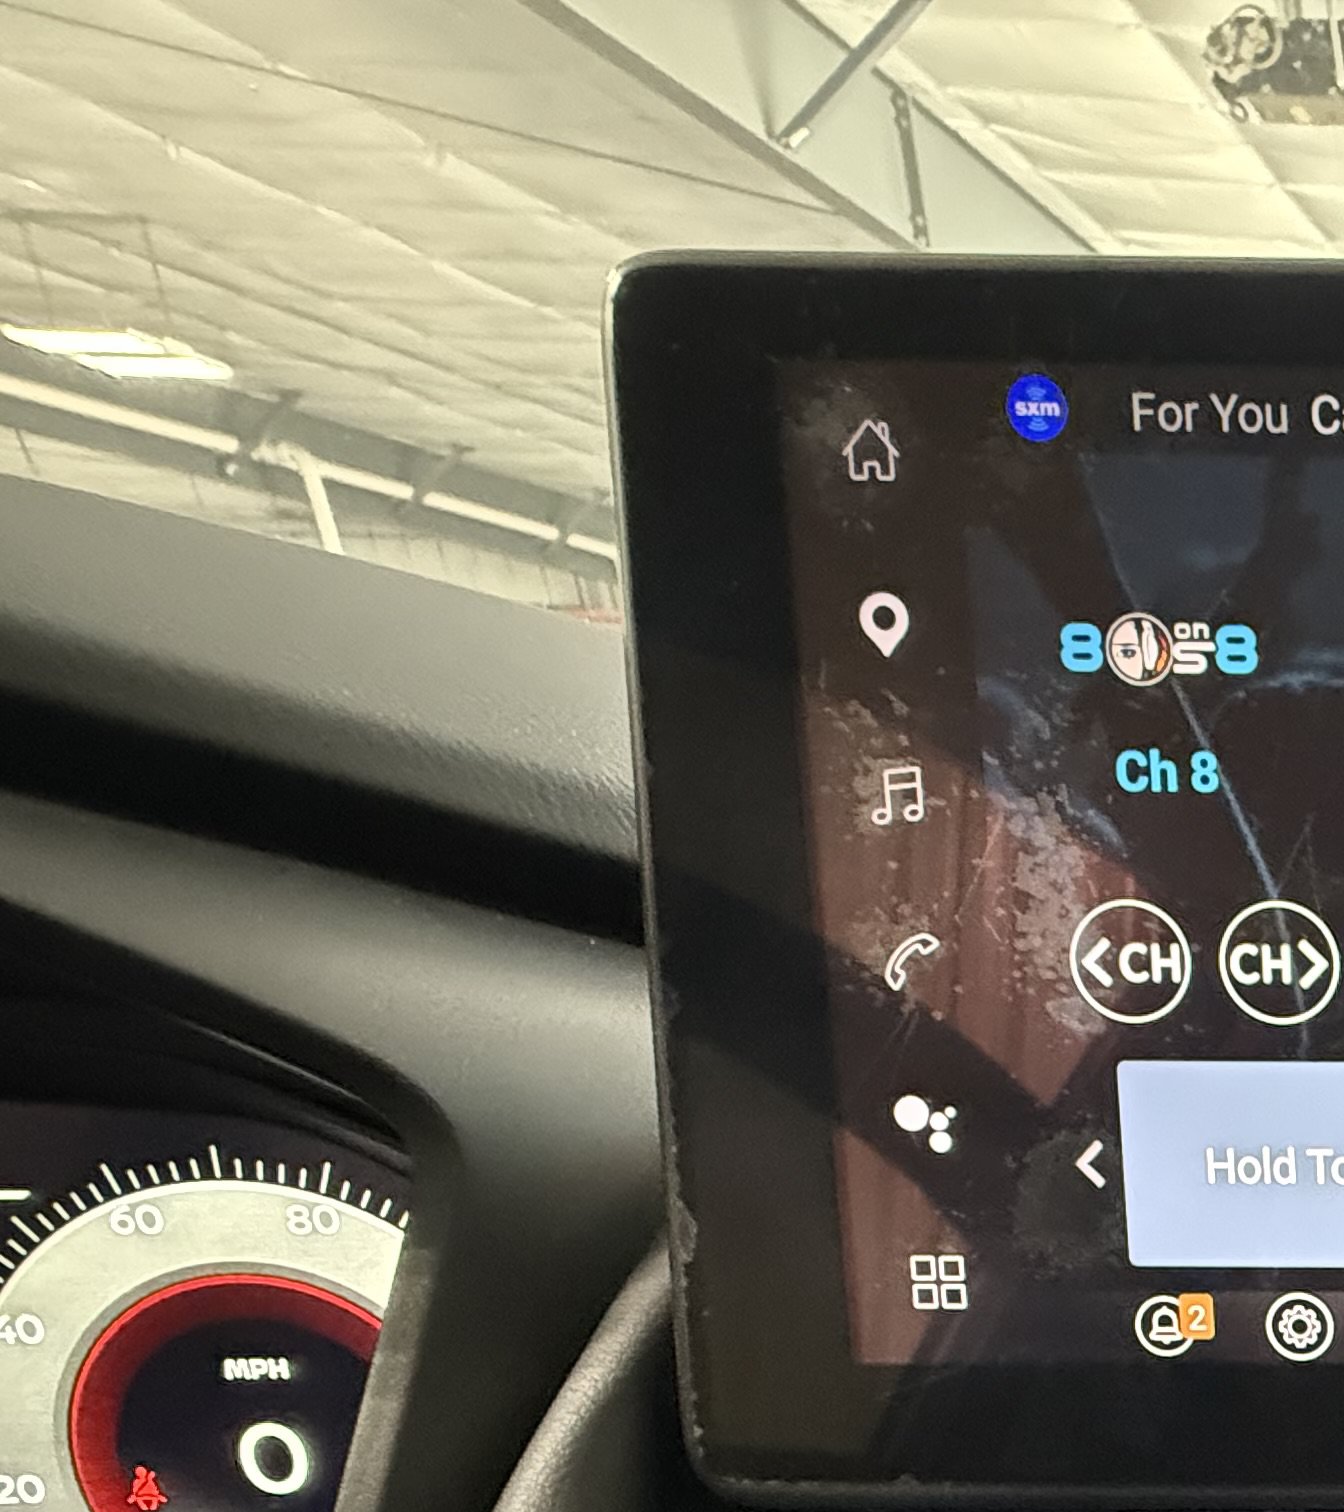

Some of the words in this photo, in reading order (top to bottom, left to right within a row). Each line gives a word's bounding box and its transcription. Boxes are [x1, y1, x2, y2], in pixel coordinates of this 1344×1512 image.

[1014, 397, 1061, 417] sxm
[1131, 392, 1199, 432] For
[1209, 393, 1289, 434] You
[1115, 748, 1178, 793] Ch
[1190, 750, 1219, 793] 8
[1118, 942, 1182, 984] CH
[1230, 943, 1292, 984] CH
[1205, 1147, 1298, 1186] Hold
[109, 1204, 164, 1236] 60
[285, 1204, 341, 1237] 80
[1188, 1306, 1207, 1331] 2
[223, 1358, 290, 1381] MPH
[240, 1422, 309, 1495] 0
